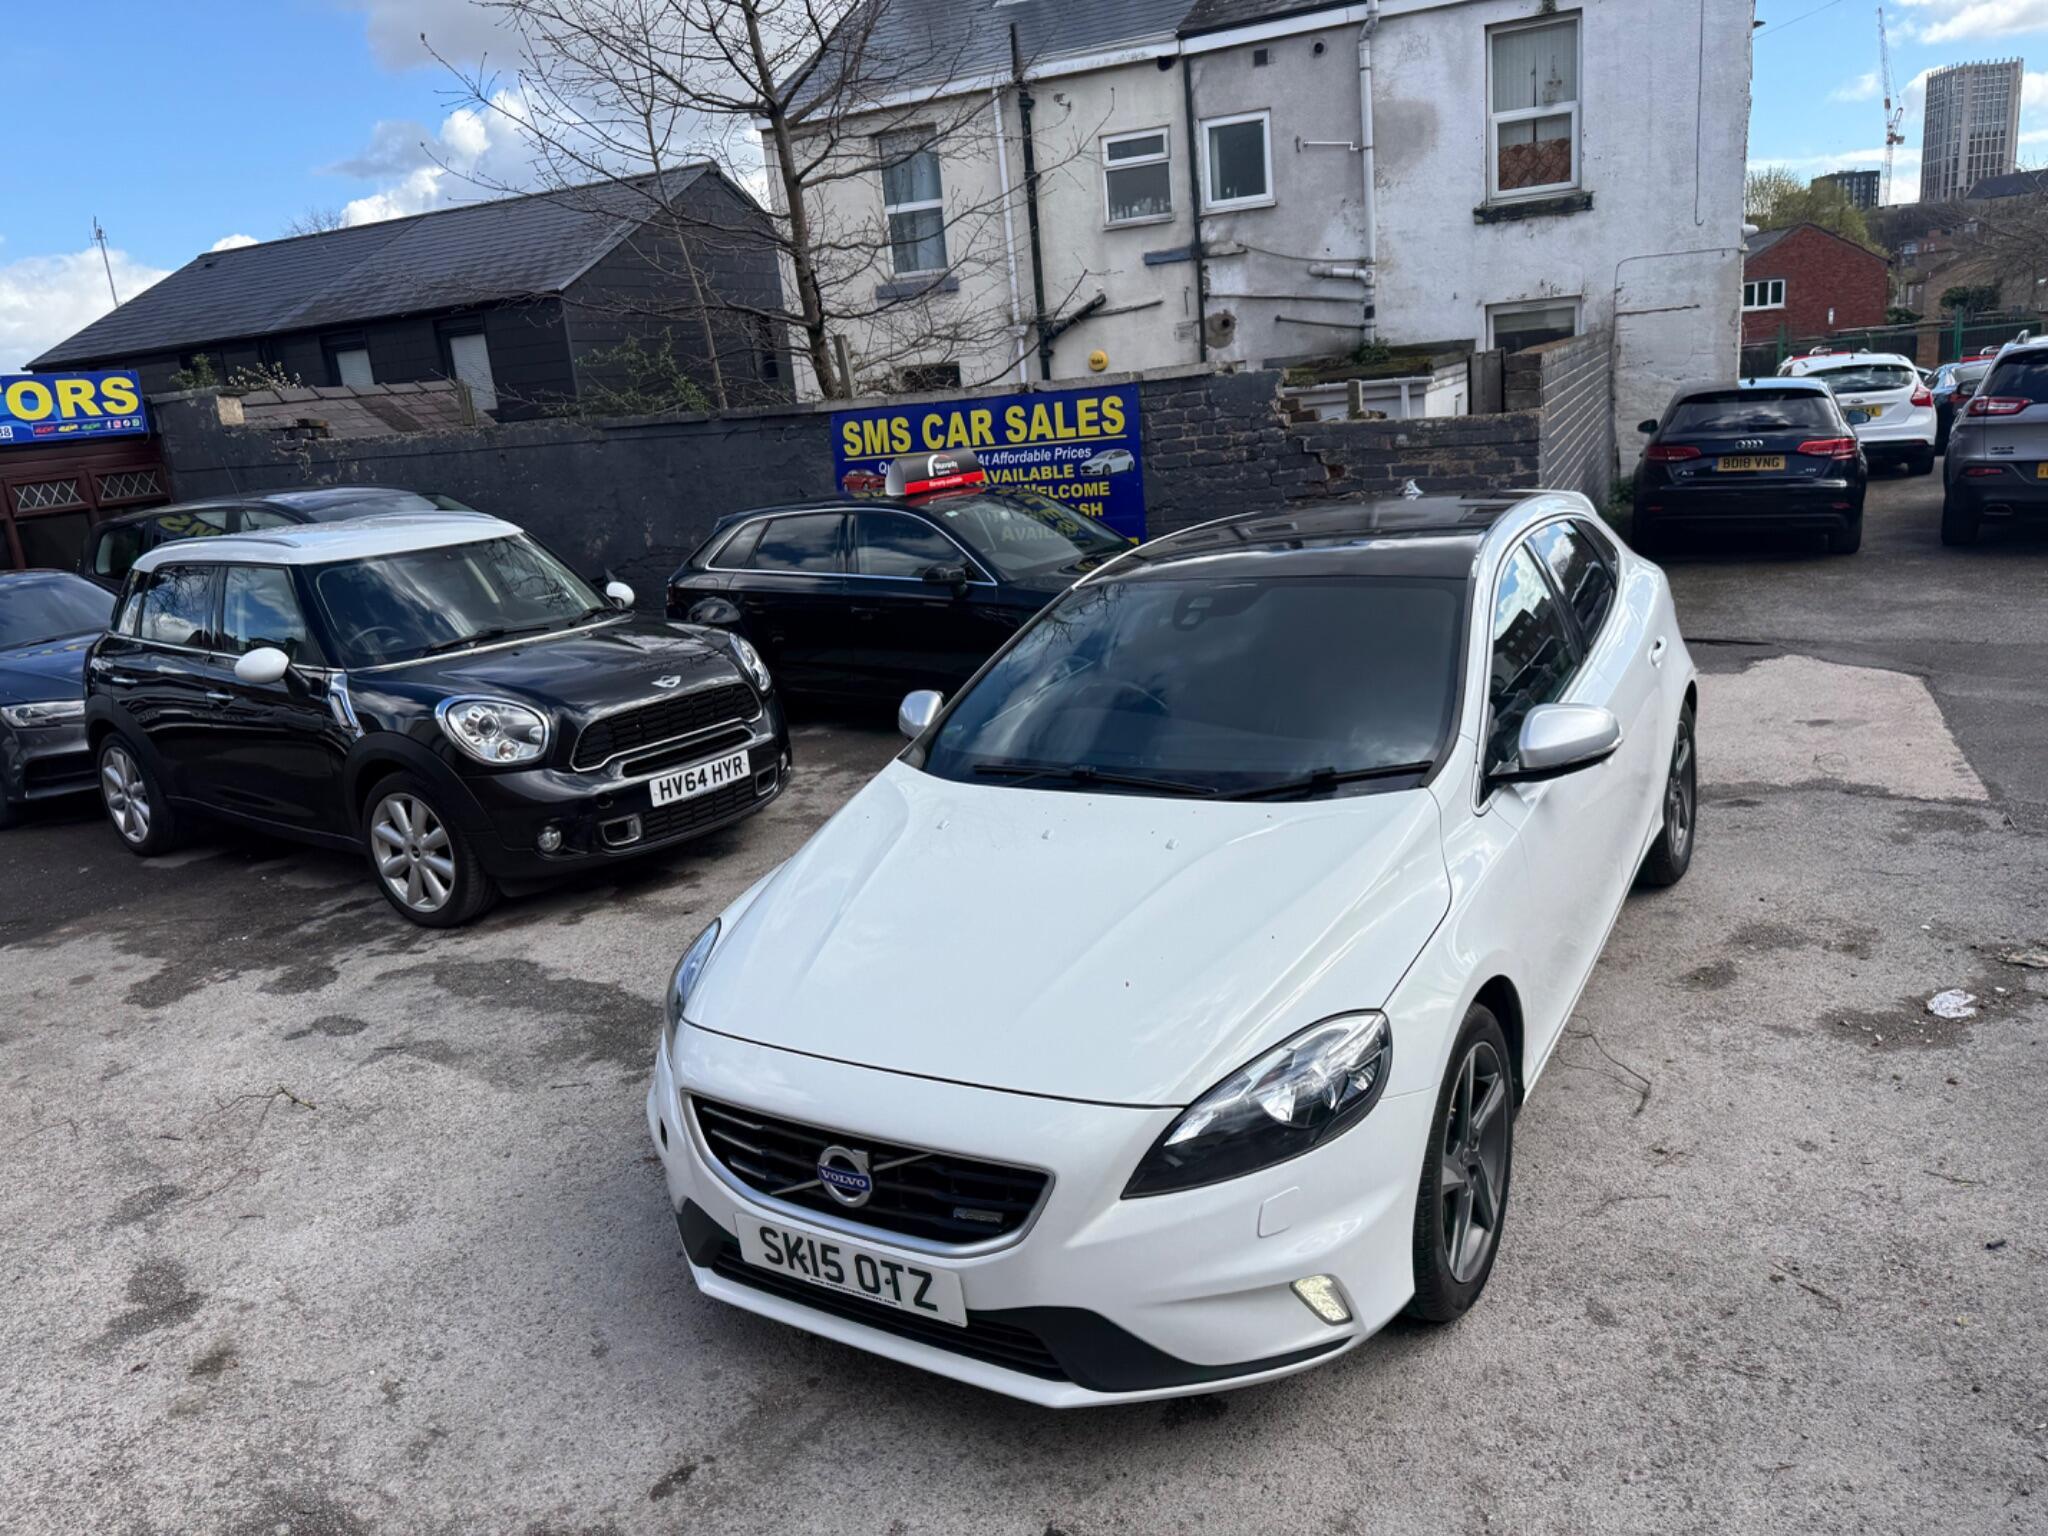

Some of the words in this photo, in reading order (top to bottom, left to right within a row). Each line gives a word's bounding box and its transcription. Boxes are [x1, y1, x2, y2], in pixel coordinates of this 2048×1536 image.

[0, 377, 139, 421] ORS
[842, 416, 912, 457] SMS
[922, 408, 995, 450] CAR
[1005, 395, 1126, 444] SALES
[977, 453, 989, 466] At
[992, 449, 1051, 466] Affordable
[1054, 446, 1092, 461] Prices
[1754, 456, 1780, 468] VNG
[977, 464, 1075, 485] AVAILABLE
[658, 769, 708, 801] HV64
[711, 756, 744, 783] HYR
[821, 1168, 867, 1189] VOLVO
[759, 1226, 845, 1284] SK15
[854, 1253, 939, 1313] OTZ
